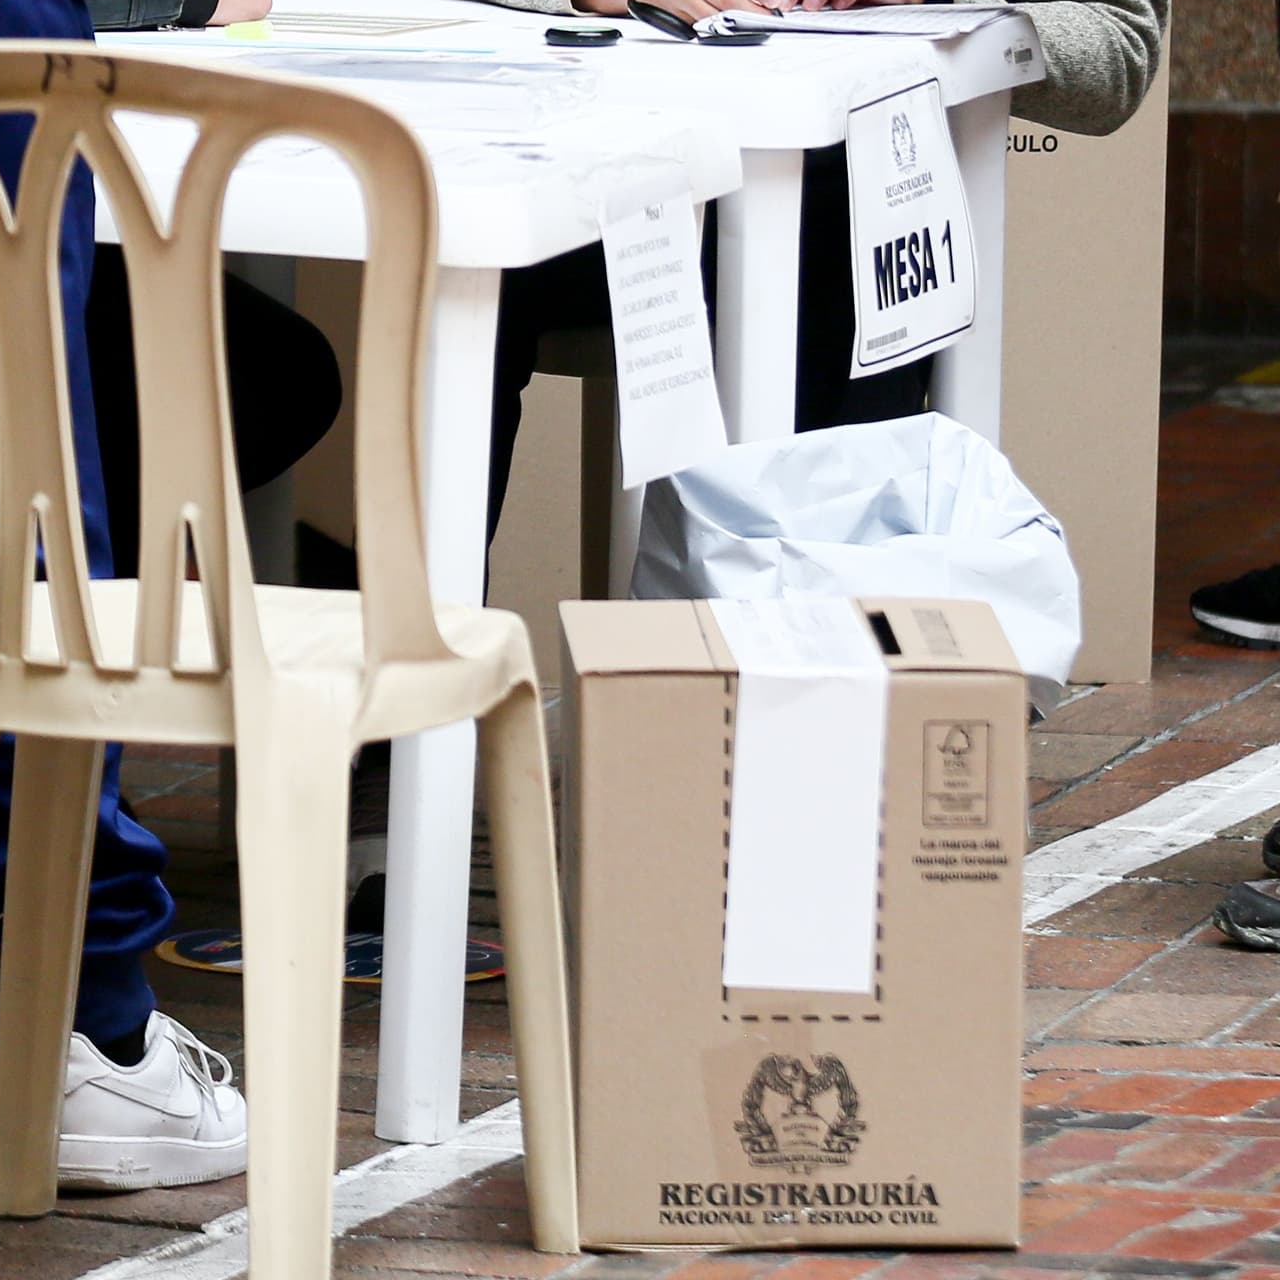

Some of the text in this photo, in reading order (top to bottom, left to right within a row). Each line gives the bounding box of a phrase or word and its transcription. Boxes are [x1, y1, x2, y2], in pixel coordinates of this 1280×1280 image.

[873, 219, 955, 311] MESA 1
[659, 1174, 940, 1207] REGISTRADURÍA
[659, 1210, 753, 1225] NACIONAL
[808, 1209, 883, 1225] ESTADO
[888, 1210, 938, 1225] CIVIL
